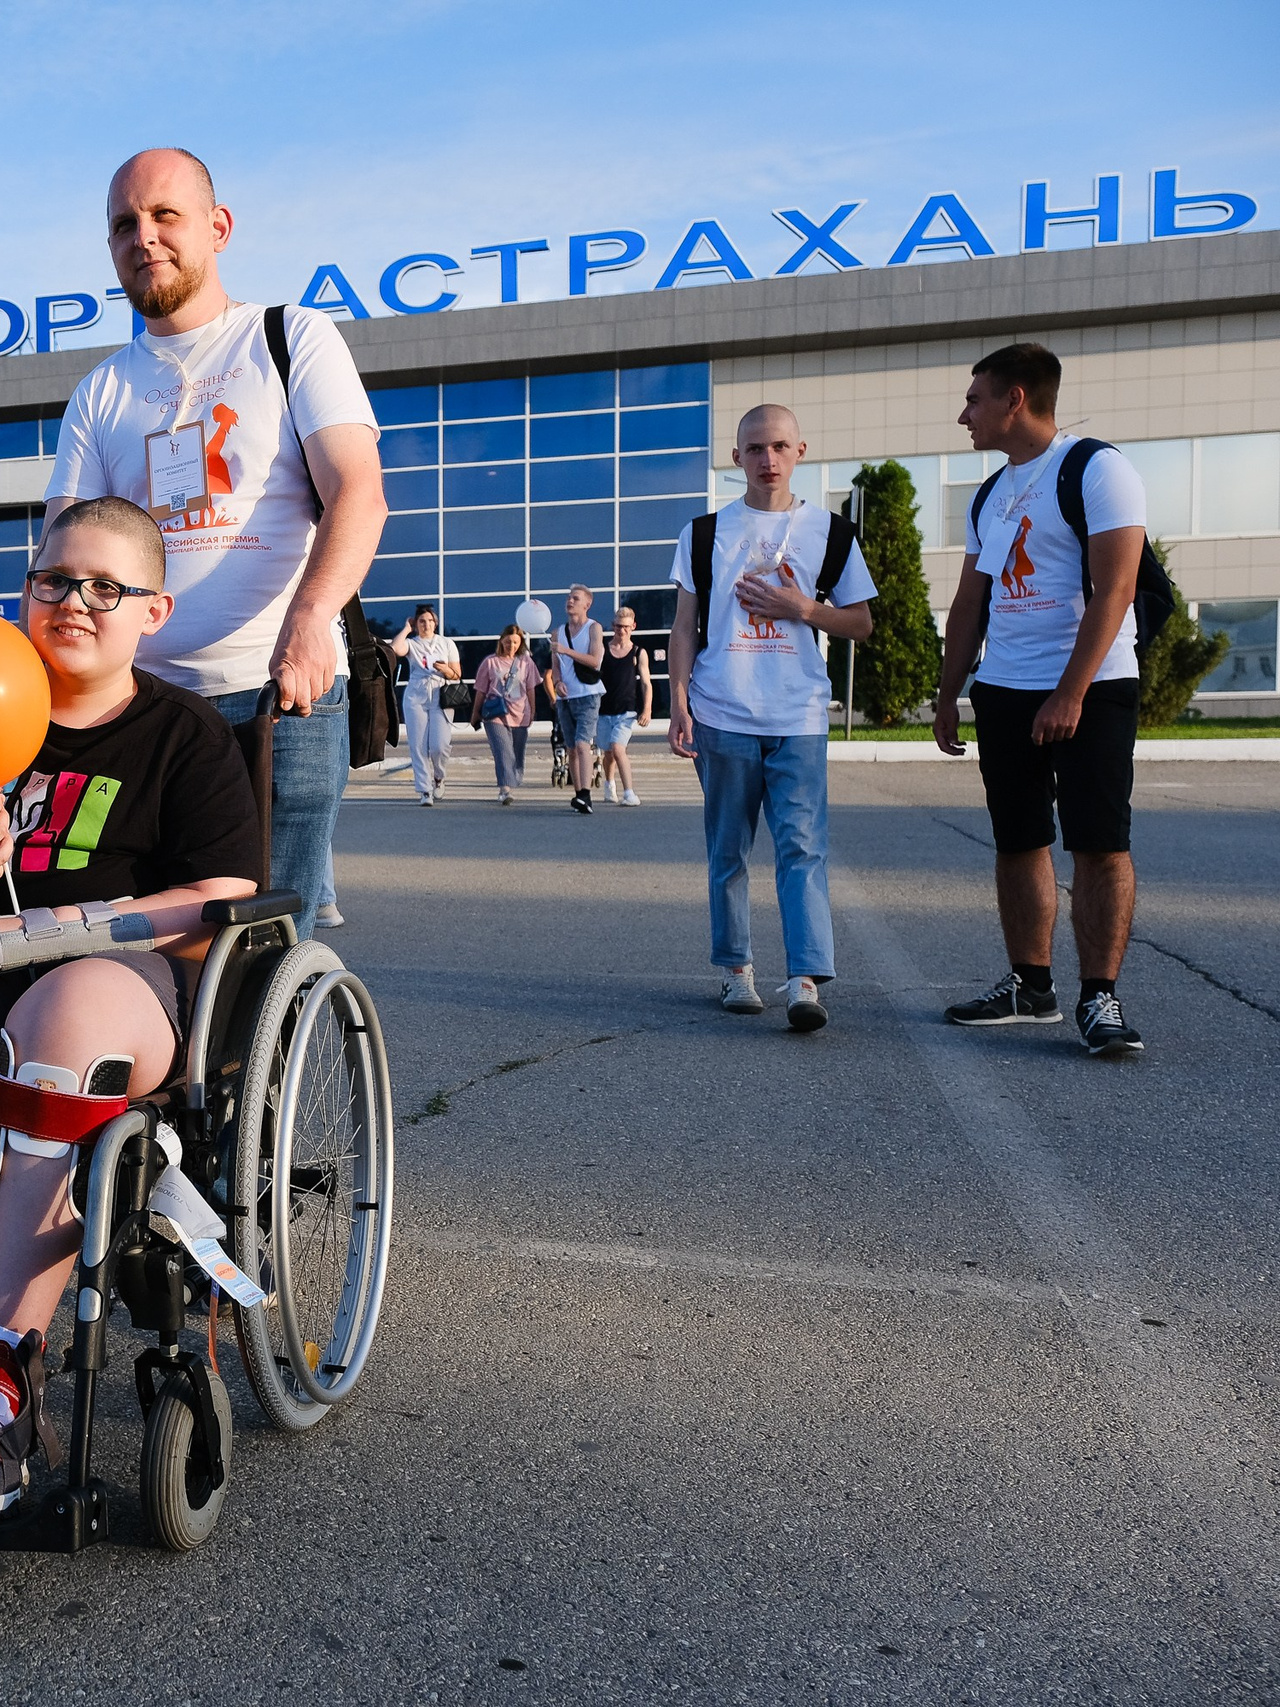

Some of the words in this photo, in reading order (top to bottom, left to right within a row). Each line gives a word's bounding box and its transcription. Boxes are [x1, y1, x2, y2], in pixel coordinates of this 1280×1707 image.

[297, 167, 1258, 320] АСТРАХАНЬ
[144, 367, 244, 404] Осоенное
[159, 387, 226, 414] счстье
[163, 535, 219, 548] ОССИЙСКАЯ
[222, 535, 260, 544] ПРЕМИЯ
